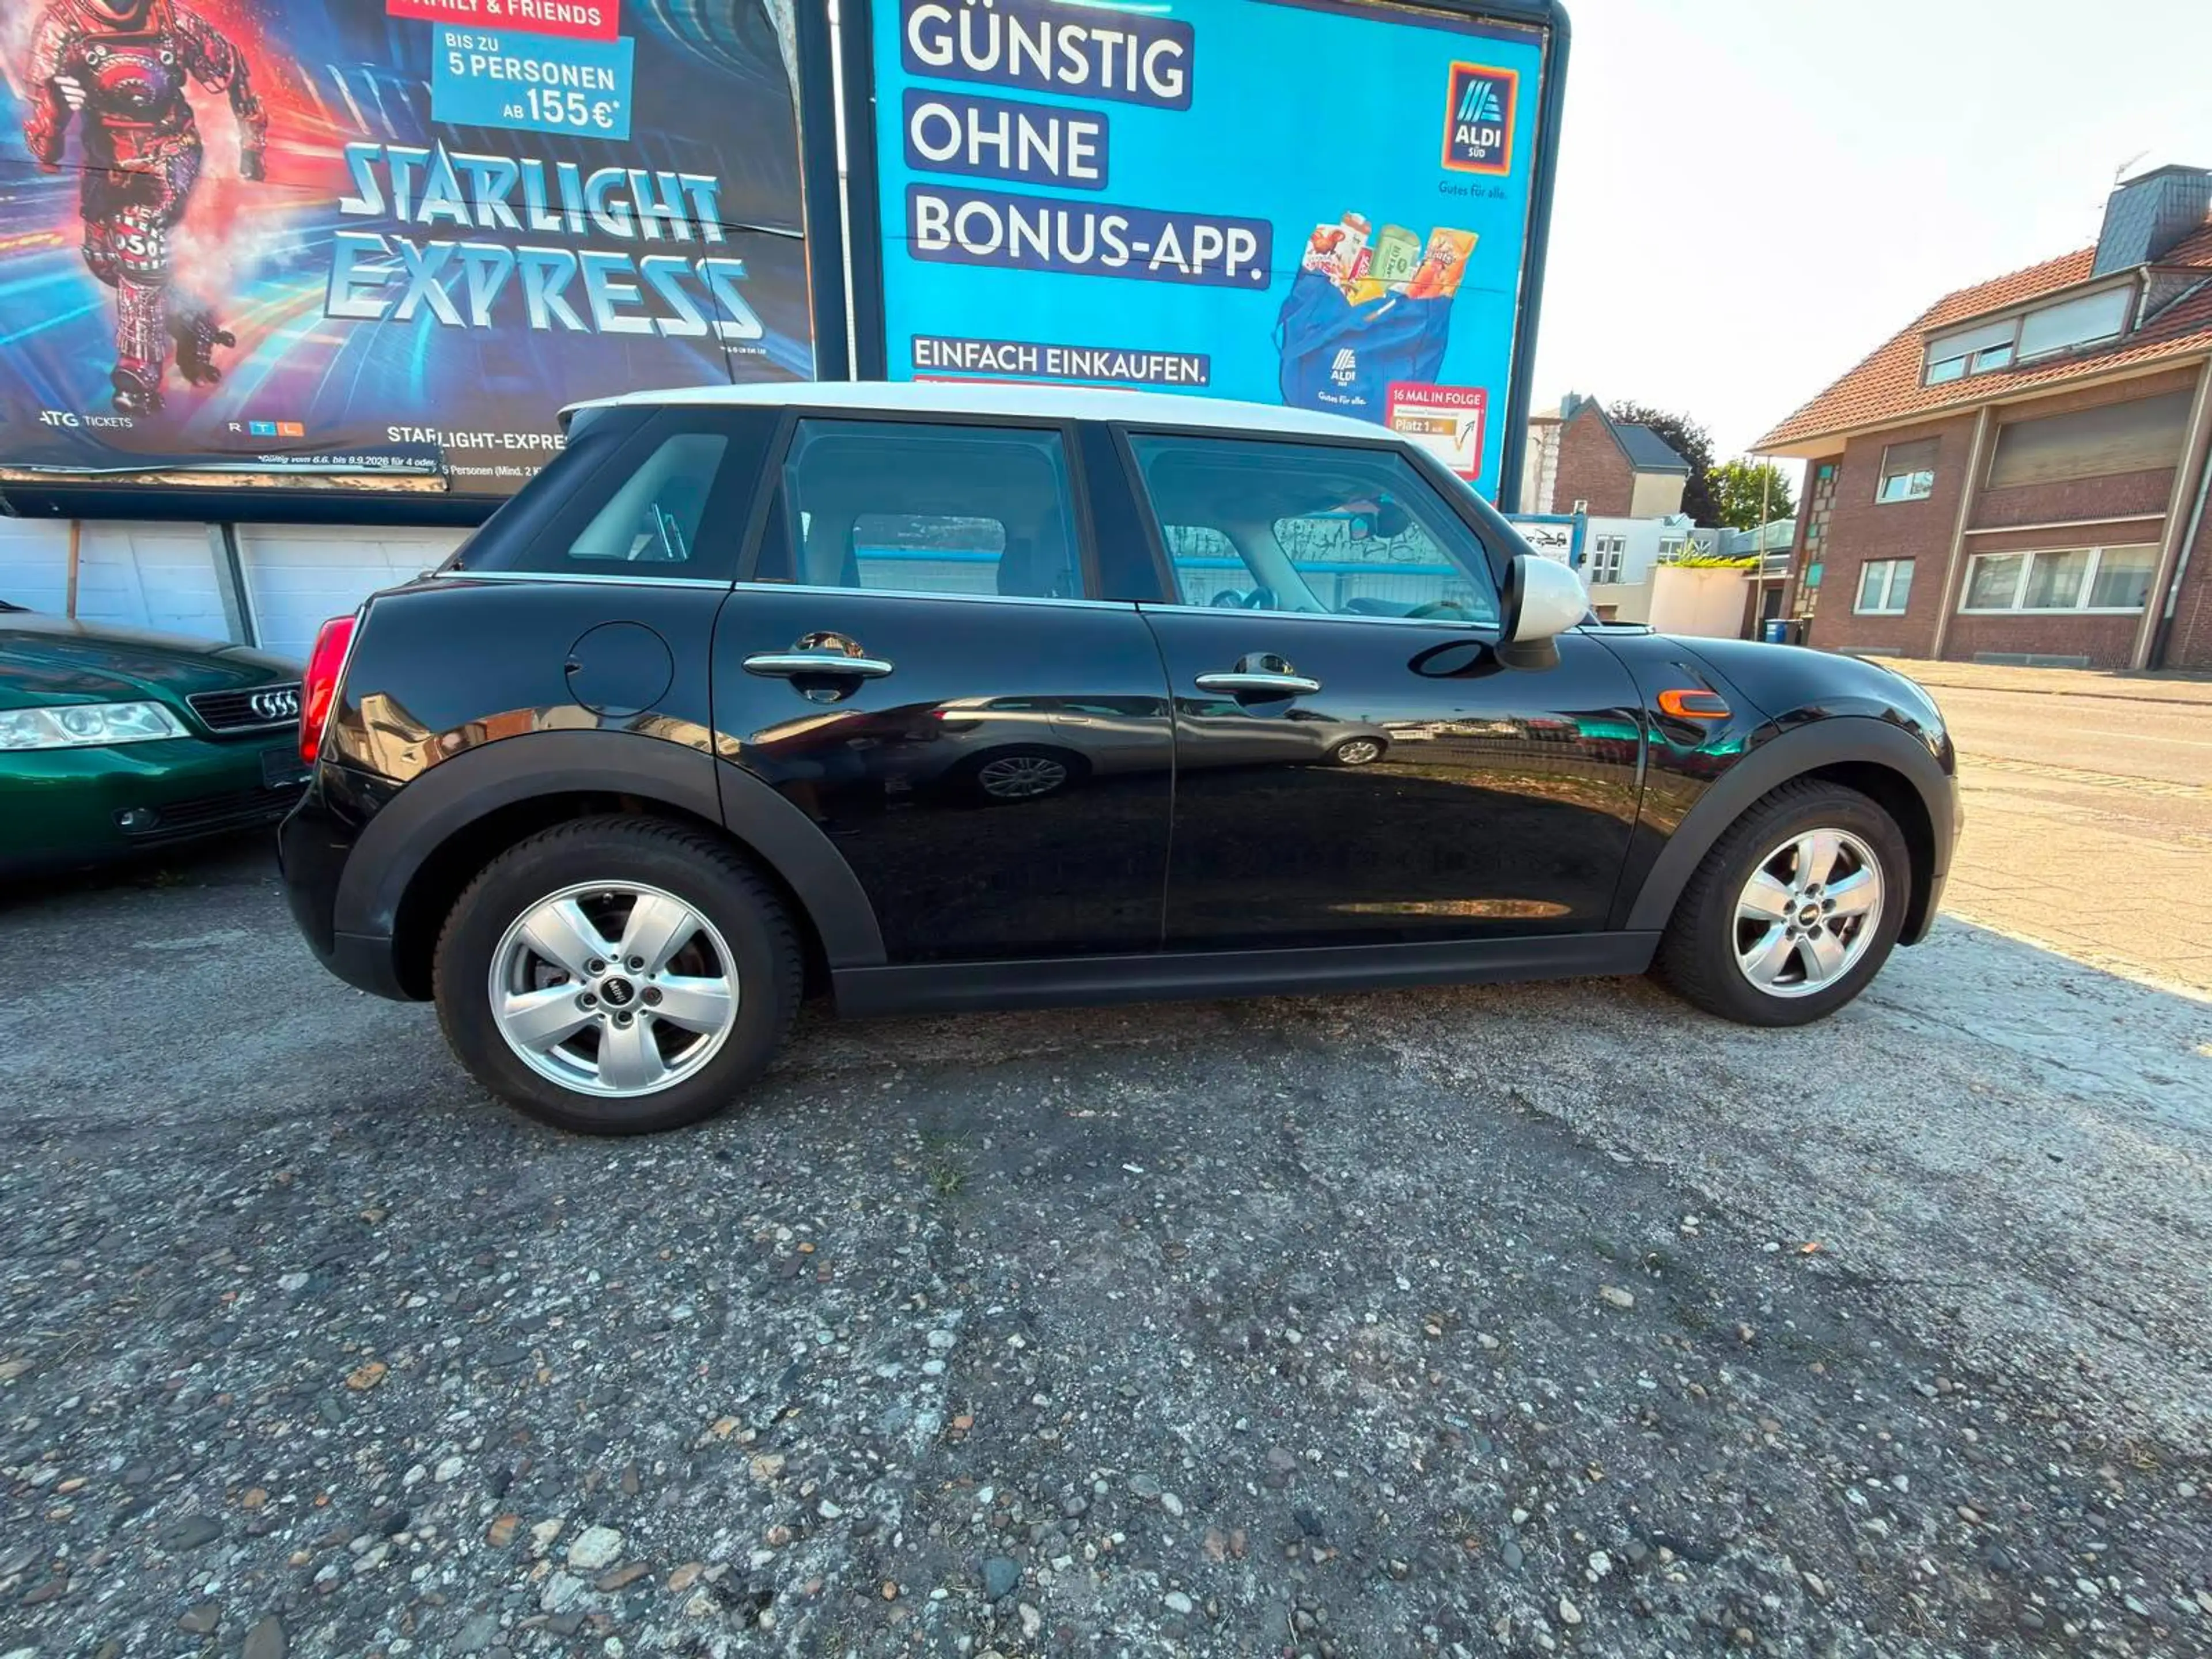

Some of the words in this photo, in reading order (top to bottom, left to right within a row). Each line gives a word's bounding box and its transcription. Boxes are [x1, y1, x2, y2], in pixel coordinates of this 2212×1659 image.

[486, 0, 502, 14] &
[509, 0, 601, 26] FRIENDS
[445, 32, 474, 50] BIS
[477, 36, 498, 52] ZU
[908, 0, 1184, 99] GÜNSTIG
[449, 52, 464, 75] 5
[471, 54, 615, 90] PERSONEN
[503, 104, 524, 119] AB
[911, 103, 1099, 179] OHNE
[1455, 125, 1501, 147] ALDI
[1468, 146, 1486, 158] SÜD
[339, 138, 726, 244] STARLIGHT
[1438, 180, 1468, 196] Gutes
[1471, 183, 1486, 198] für
[916, 195, 1262, 280] BONUS-APP.
[326, 230, 765, 340] EXPRESS
[915, 339, 1037, 372] EINFACH
[1047, 348, 1206, 383] EINKAUFEN.
[1331, 370, 1355, 381] ALDI
[1394, 389, 1404, 401] 16
[1406, 390, 1430, 402] MAL
[1431, 392, 1443, 403] IN
[1446, 393, 1481, 405] FOLGE
[39, 410, 79, 427] ATG
[82, 415, 133, 428] TICKETS
[1396, 420, 1421, 431] Platz
[1424, 421, 1429, 431] 1
[387, 426, 568, 450] STARLIGHT-EXPRE
[333, 456, 346, 464] bis
[349, 456, 389, 465] 9.9.2026
[391, 456, 404, 465] für
[442, 465, 449, 475] 5
[450, 465, 493, 475] Personen
[495, 466, 523, 478] (Mind.
[525, 466, 533, 476] 2
